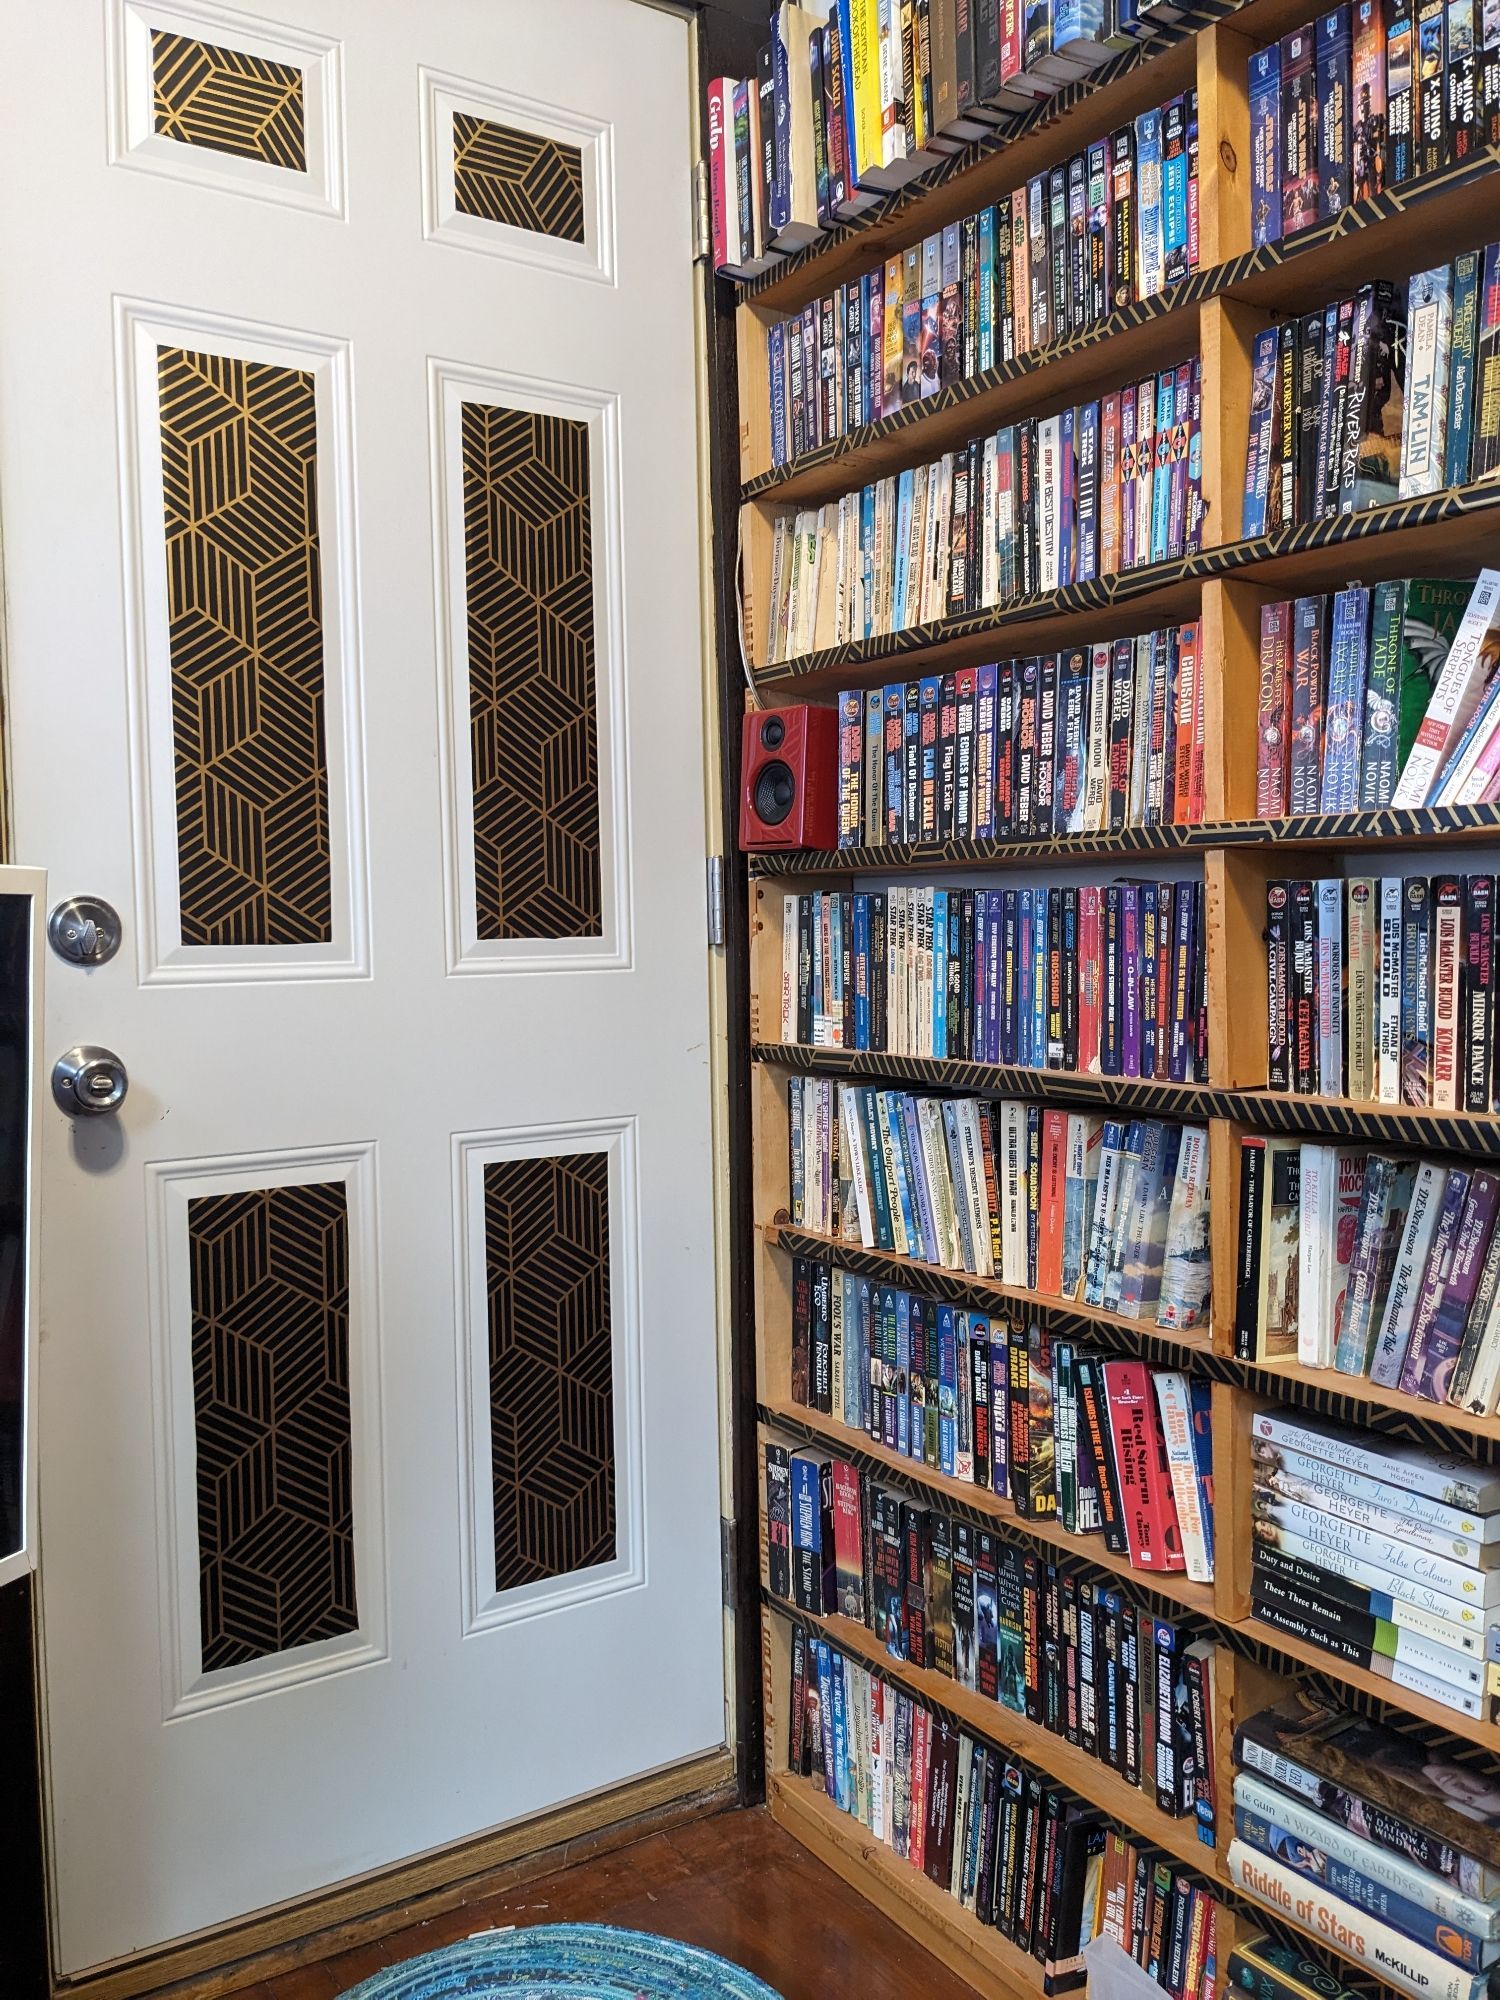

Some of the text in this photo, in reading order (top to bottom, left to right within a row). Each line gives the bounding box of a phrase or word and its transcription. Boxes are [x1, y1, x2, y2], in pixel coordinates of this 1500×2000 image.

[830, 29, 842, 109] JOHN SCALZI
[1463, 57, 1474, 123] X-WING
[1430, 80, 1440, 140] X-WING
[1122, 200, 1130, 242] BALANCE
[1189, 183, 1197, 258] ONSLAUGHT
[791, 335, 800, 362] SIMON
[1425, 313, 1434, 351] PAMELA
[792, 372, 801, 398] GREEN
[1283, 350, 1292, 458] THE FOREVER WAR
[1453, 366, 1465, 430] Alan Dean Foster
[1343, 387, 1366, 490] RIVER RATS
[954, 476, 967, 515] SANTORINI
[1044, 486, 1055, 557] BEST DESTINY
[1080, 470, 1093, 520] TITAN
[1296, 647, 1309, 690] WAR
[1310, 630, 1319, 707] BLACK POWDER
[1373, 636, 1386, 679] JADE
[1386, 614, 1400, 695] THRONE OF
[1181, 656, 1194, 726] CRUSADE
[1041, 691, 1054, 756] DAVID WEBER
[1094, 679, 1103, 767] MUTINEERS' MOON
[909, 769, 916, 780] Of
[942, 746, 954, 811] Flag In Exile
[958, 737, 970, 824] ECHOES OF HONOR
[1365, 761, 1377, 804] NOVIK
[1380, 760, 1391, 804] NAOMI
[926, 906, 934, 951] STAR TREK
[1051, 950, 1060, 1007] CROSSROAD
[1178, 968, 1186, 976] IS
[1177, 991, 1185, 1020] HUNTER
[1436, 918, 1454, 1081] LOIS McMASTER BUJOLD KOMARR
[1382, 1022, 1390, 1055] ATHOS
[1391, 1051, 1398, 1062] OF
[1471, 991, 1485, 1086] MIRROR DANCE
[866, 1093, 877, 1150] FARLEY MOWAT
[882, 1127, 900, 1222] The Outport People
[1009, 1126, 1017, 1196] ULTRA GOES TO WAR
[1030, 1132, 1038, 1210] SILENT SQUADRON
[1246, 1220, 1253, 1228] OF
[1427, 1212, 1454, 1285] The Musgraves
[1244, 1229, 1253, 1279] CASTERBRIDGE
[834, 1294, 842, 1356] FOOL'S WAR
[1382, 1265, 1412, 1355] The Enchanted Isle
[1010, 1346, 1020, 1388] DRAKE
[1020, 1350, 1028, 1388] DAVID
[1083, 1387, 1096, 1420] ISLANDS
[1090, 1429, 1100, 1441] THE
[1092, 1443, 1103, 1461] NET
[1120, 1429, 1137, 1485] Rising
[1132, 1409, 1151, 1504] Red Storm
[1097, 1466, 1109, 1488] Bruce
[1100, 1490, 1115, 1522] Sterling
[1135, 1511, 1146, 1548] Clancy
[800, 1501, 813, 1591] STEPHEN KING THE STAND
[1142, 1522, 1151, 1546] Tom
[1259, 1550, 1321, 1583] Duty and Desire
[1263, 1580, 1341, 1622] These Three Remain
[1260, 1606, 1360, 1659] An Assembly Such as This
[1158, 1654, 1174, 1743] ELIZABETH MOON
[1192, 1688, 1204, 1769] ROBERT A. HEINLEIN
[1157, 1743, 1165, 1789] COMMAND
[1164, 1747, 1174, 1792] CHANGE OF
[1242, 1860, 1366, 1956] Riddle of Stars
[1186, 1898, 1204, 1993] SHARYN McCRUMB
[1375, 1948, 1429, 1986] McKILLIP
